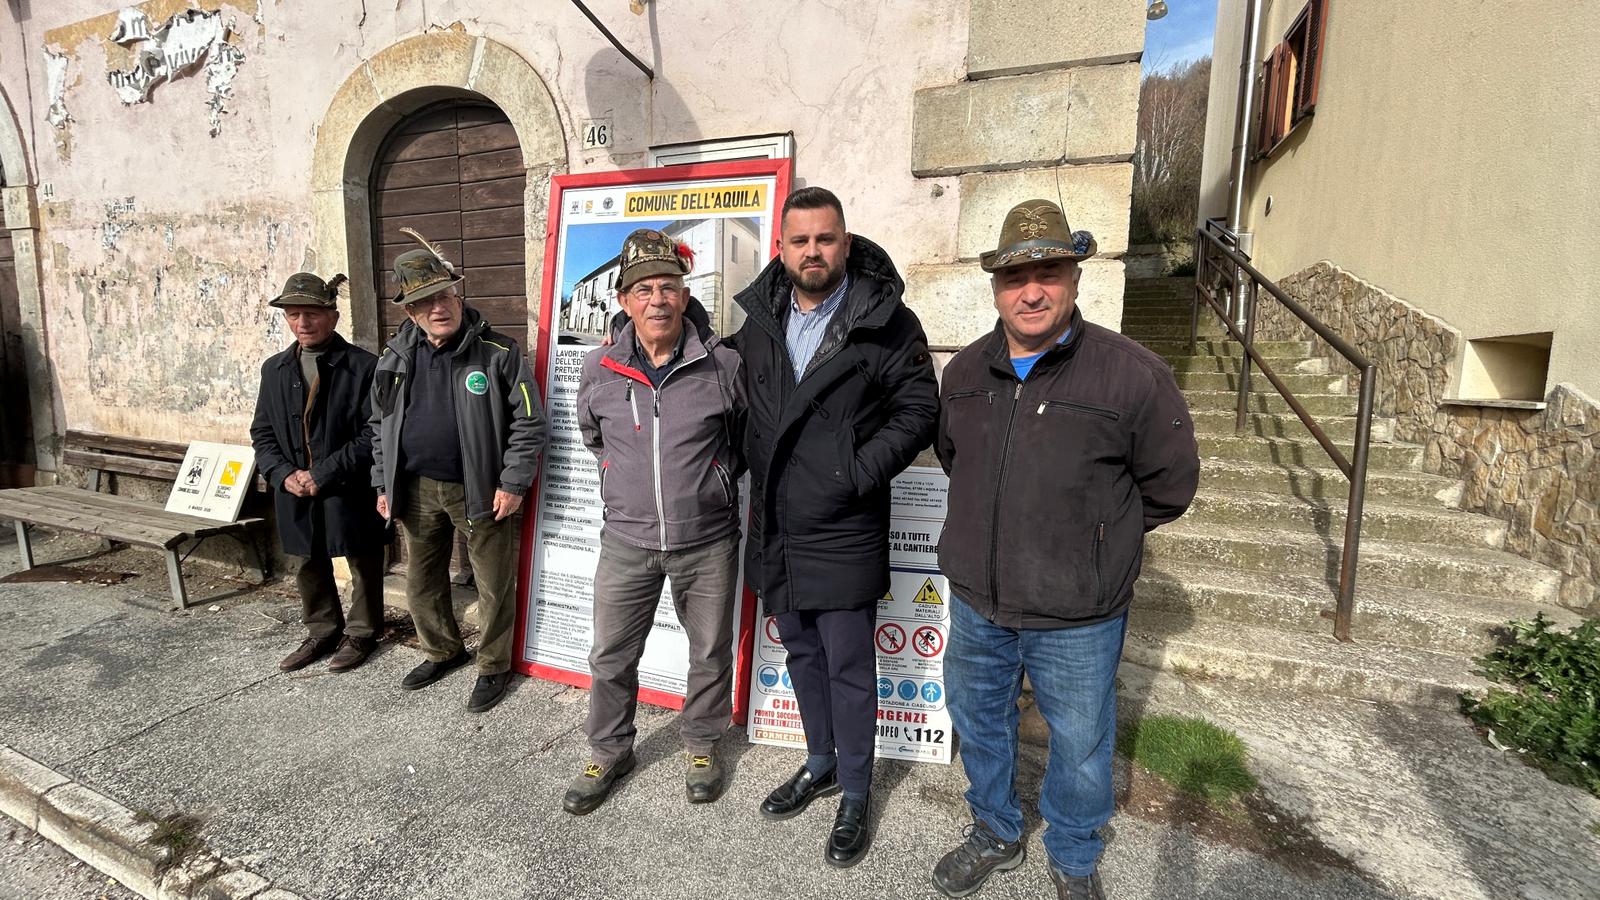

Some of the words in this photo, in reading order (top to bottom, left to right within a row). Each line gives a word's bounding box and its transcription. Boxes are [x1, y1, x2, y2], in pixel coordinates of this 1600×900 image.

[586, 125, 607, 146] 46
[43, 183, 54, 197] 44
[628, 194, 677, 213] COMUNE
[681, 189, 760, 210] DELL'AQUILA
[555, 350, 579, 358] LAVORI
[555, 358, 583, 366] DELL'ED
[554, 514, 576, 522] CONSEGNA
[562, 535, 587, 544] ESECUTRICE
[901, 532, 907, 540] A
[908, 532, 931, 542] TUTTE
[559, 542, 584, 551] COSTRUZIONI
[893, 543, 902, 551] AL
[903, 543, 938, 554] CANTIERE
[546, 601, 580, 612] AMMINISTRATIVI
[772, 698, 799, 711] CHI
[754, 708, 775, 718] PRONTO
[757, 730, 804, 742] FORMEDIL
[913, 727, 945, 744] 112
